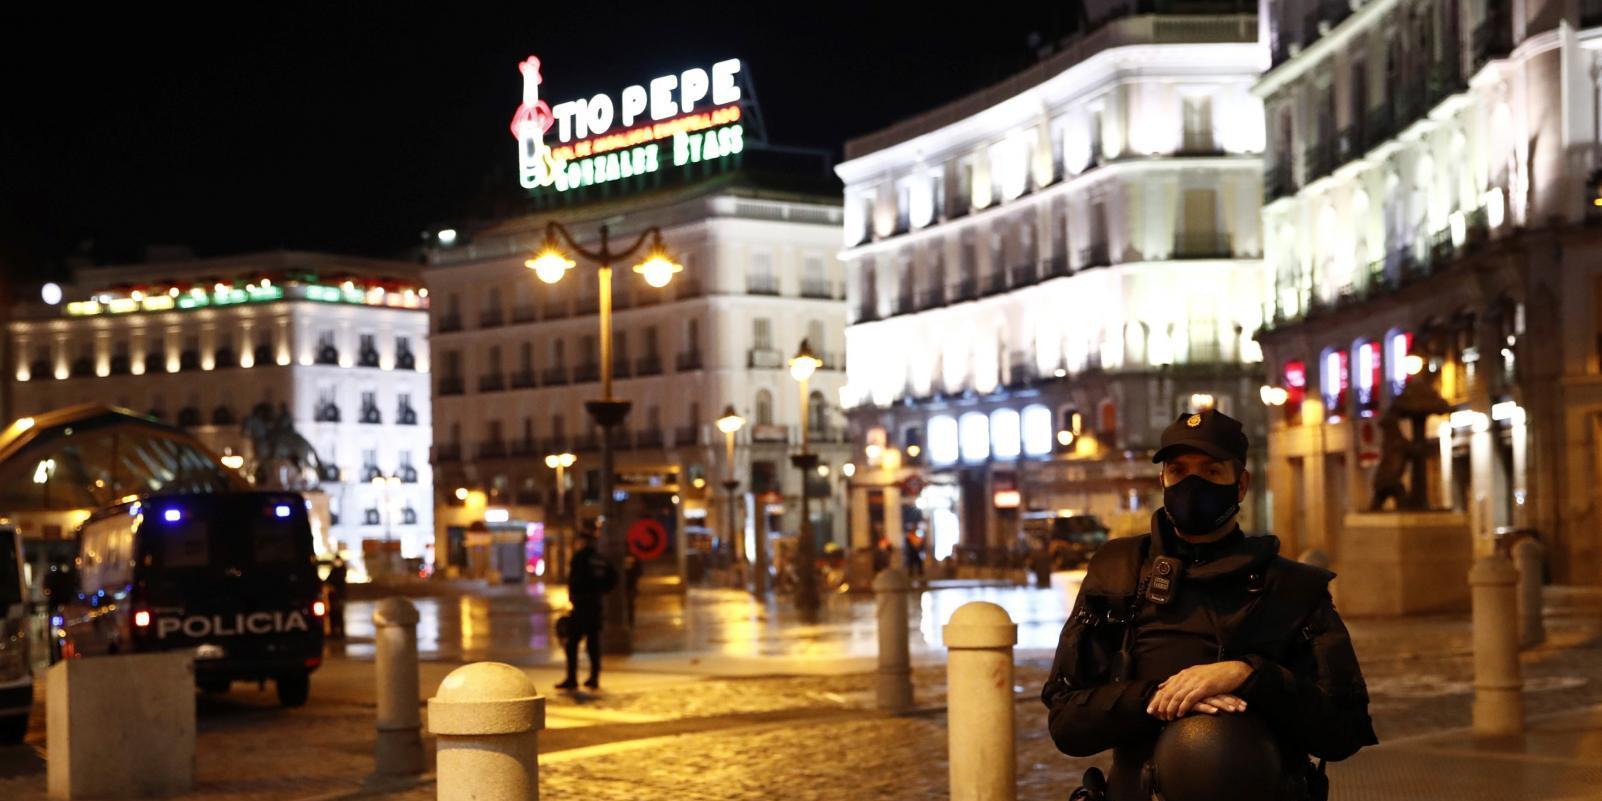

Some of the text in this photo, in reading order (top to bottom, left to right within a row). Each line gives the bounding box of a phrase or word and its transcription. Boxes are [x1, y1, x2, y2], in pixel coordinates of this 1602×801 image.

[553, 93, 614, 142] TIO
[622, 58, 741, 127] PEPE
[673, 124, 743, 166] BYASS
[157, 610, 307, 639] POLICIA
